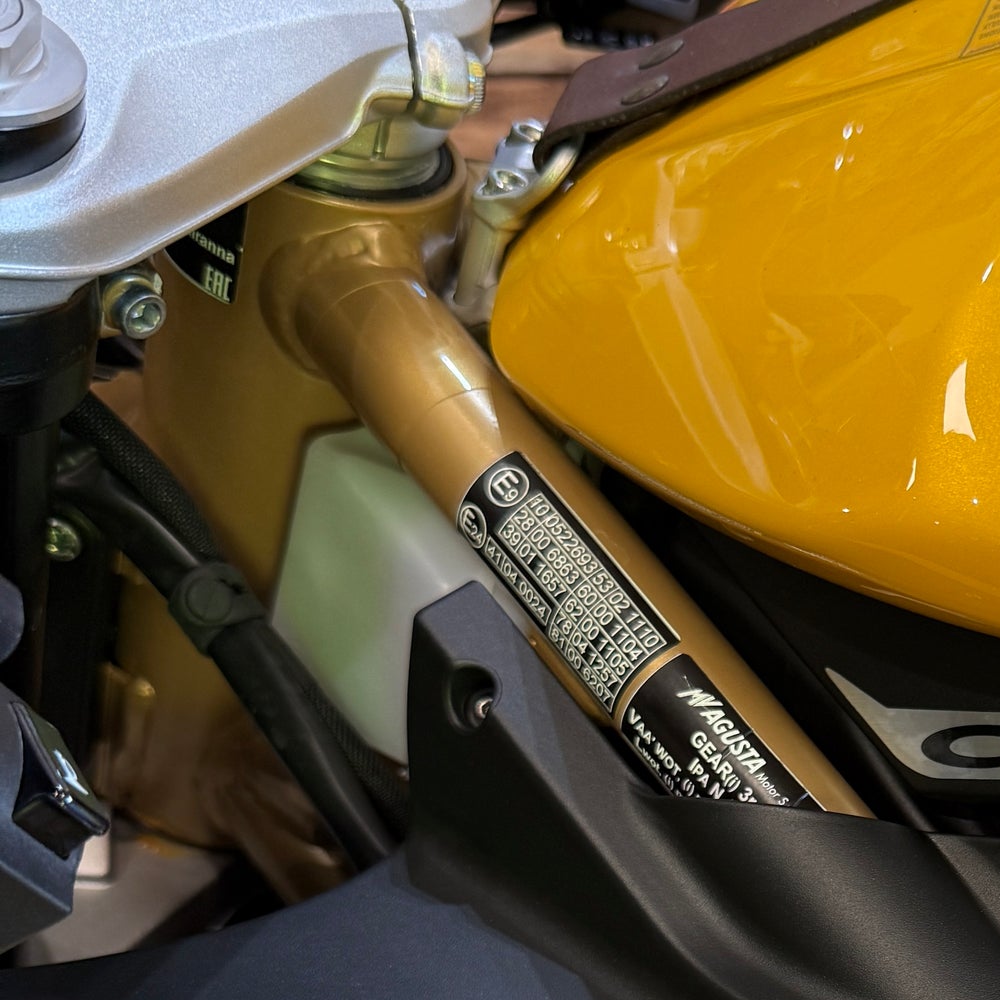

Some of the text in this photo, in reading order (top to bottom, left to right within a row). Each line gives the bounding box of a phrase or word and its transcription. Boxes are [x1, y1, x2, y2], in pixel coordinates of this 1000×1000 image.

[488, 546, 546, 618] 41 04 0024
[503, 524, 630, 676] 39 01 1657 62 00 1105
[513, 510, 643, 662] 28 00 6863 60 00 1104
[531, 498, 660, 648] 10 0522693 53 02 1110
[551, 627, 611, 704] 81 00 6207
[556, 612, 618, 687] 78 04 1257
